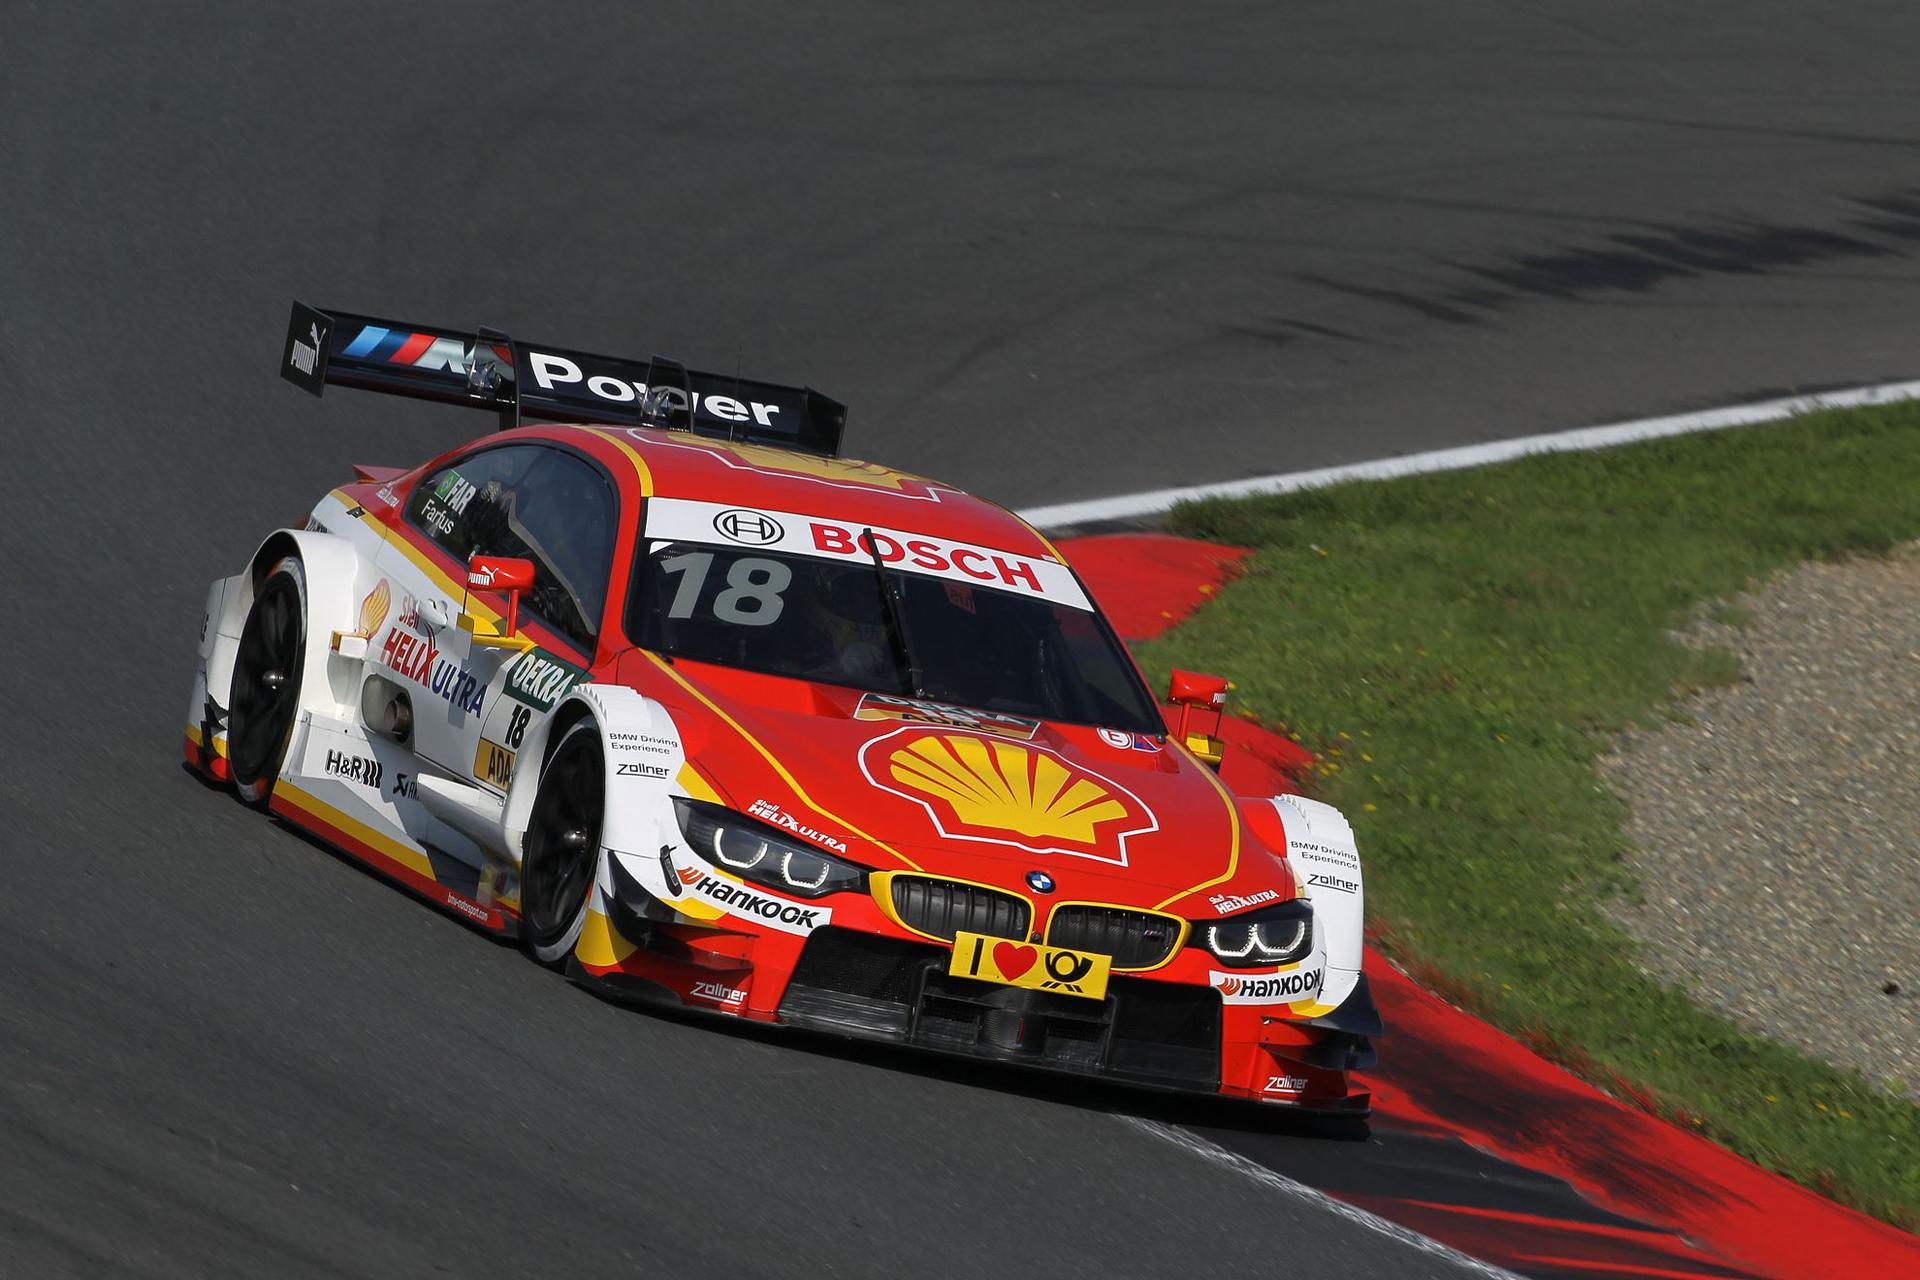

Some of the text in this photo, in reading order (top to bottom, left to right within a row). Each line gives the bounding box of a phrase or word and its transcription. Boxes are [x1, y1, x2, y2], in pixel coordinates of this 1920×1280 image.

[290, 339, 316, 376] PUMA
[444, 477, 476, 516] FAR
[421, 499, 454, 534] Farfus
[809, 522, 1046, 593] BOSCH
[660, 551, 792, 626] 18
[380, 627, 487, 718] HELIX ULTRA
[511, 654, 575, 704] DEKRA
[505, 704, 531, 749] 18
[609, 732, 678, 748] BMW Driving
[326, 749, 362, 781] H&R
[611, 742, 670, 755] Experience
[755, 799, 778, 812] Shell
[748, 803, 847, 853] HELIX ULTRA
[1290, 840, 1357, 861] BMW Driving
[1301, 852, 1358, 871] Experience
[1246, 890, 1280, 905] ULTRA
[969, 938, 984, 976] I
